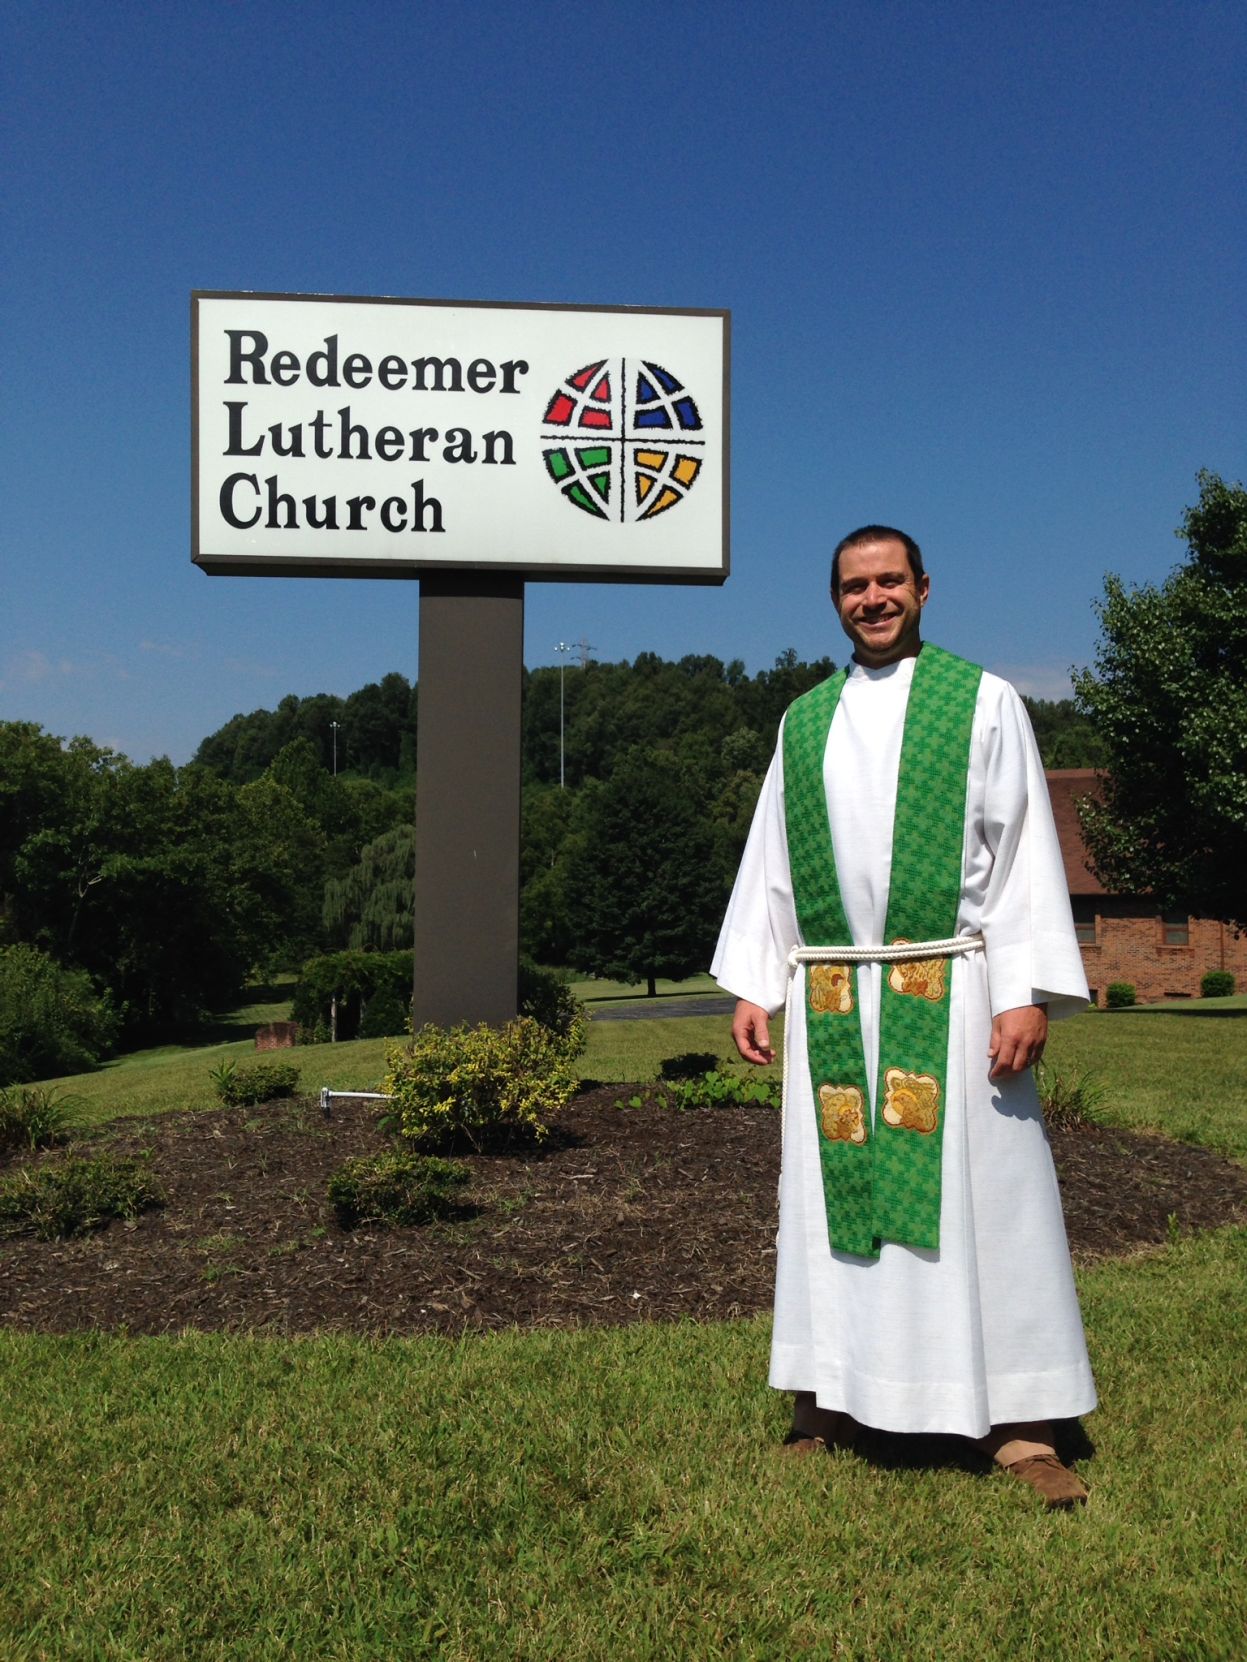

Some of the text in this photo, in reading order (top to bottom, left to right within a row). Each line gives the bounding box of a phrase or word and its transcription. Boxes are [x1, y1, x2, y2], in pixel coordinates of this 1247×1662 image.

[223, 329, 529, 394] Redeemer
[222, 401, 517, 465] Lutheran
[219, 472, 446, 533] Church
